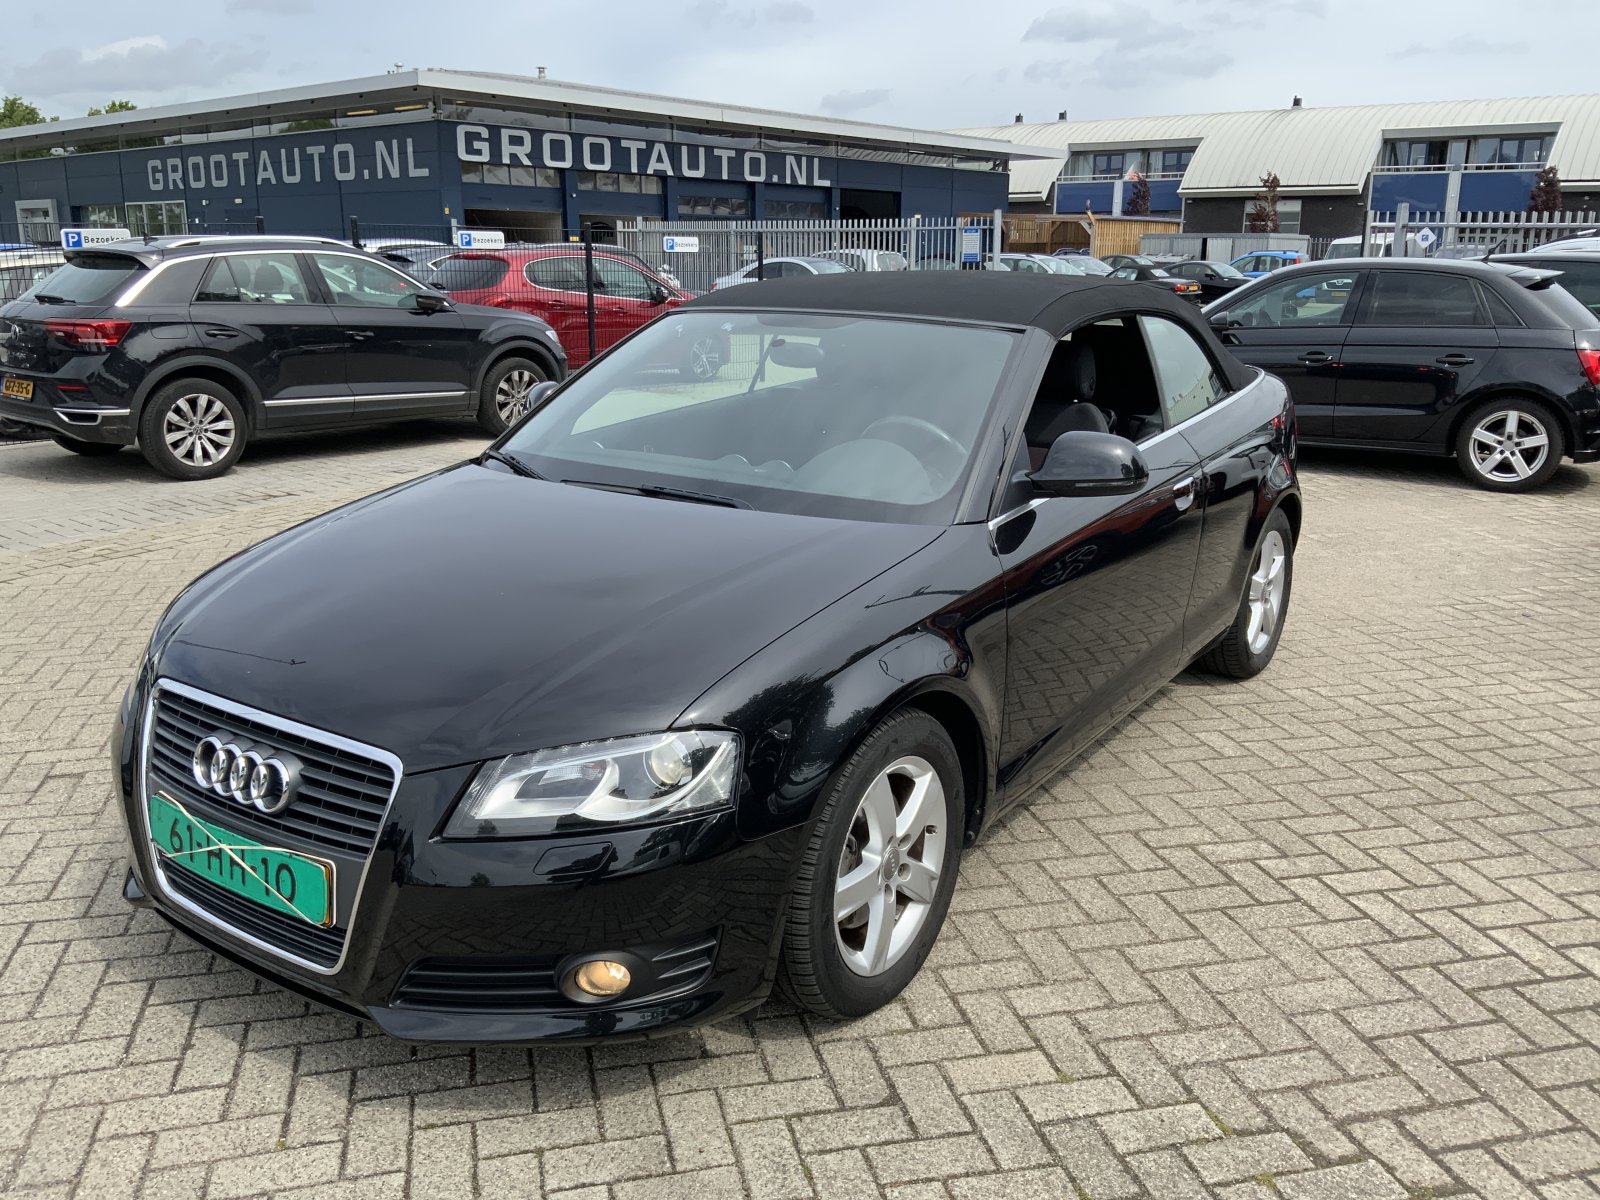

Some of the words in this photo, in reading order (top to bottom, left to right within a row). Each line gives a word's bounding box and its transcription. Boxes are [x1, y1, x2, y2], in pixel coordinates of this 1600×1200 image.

[147, 138, 430, 191] GROOTAUTO.NL
[456, 124, 832, 187] GROOTAUTO.NL
[67, 233, 79, 247] P
[84, 235, 125, 244] Bezoek
[462, 234, 470, 246] P
[472, 236, 503, 244] Bezoekers
[169, 817, 297, 905] 61-HH-10
